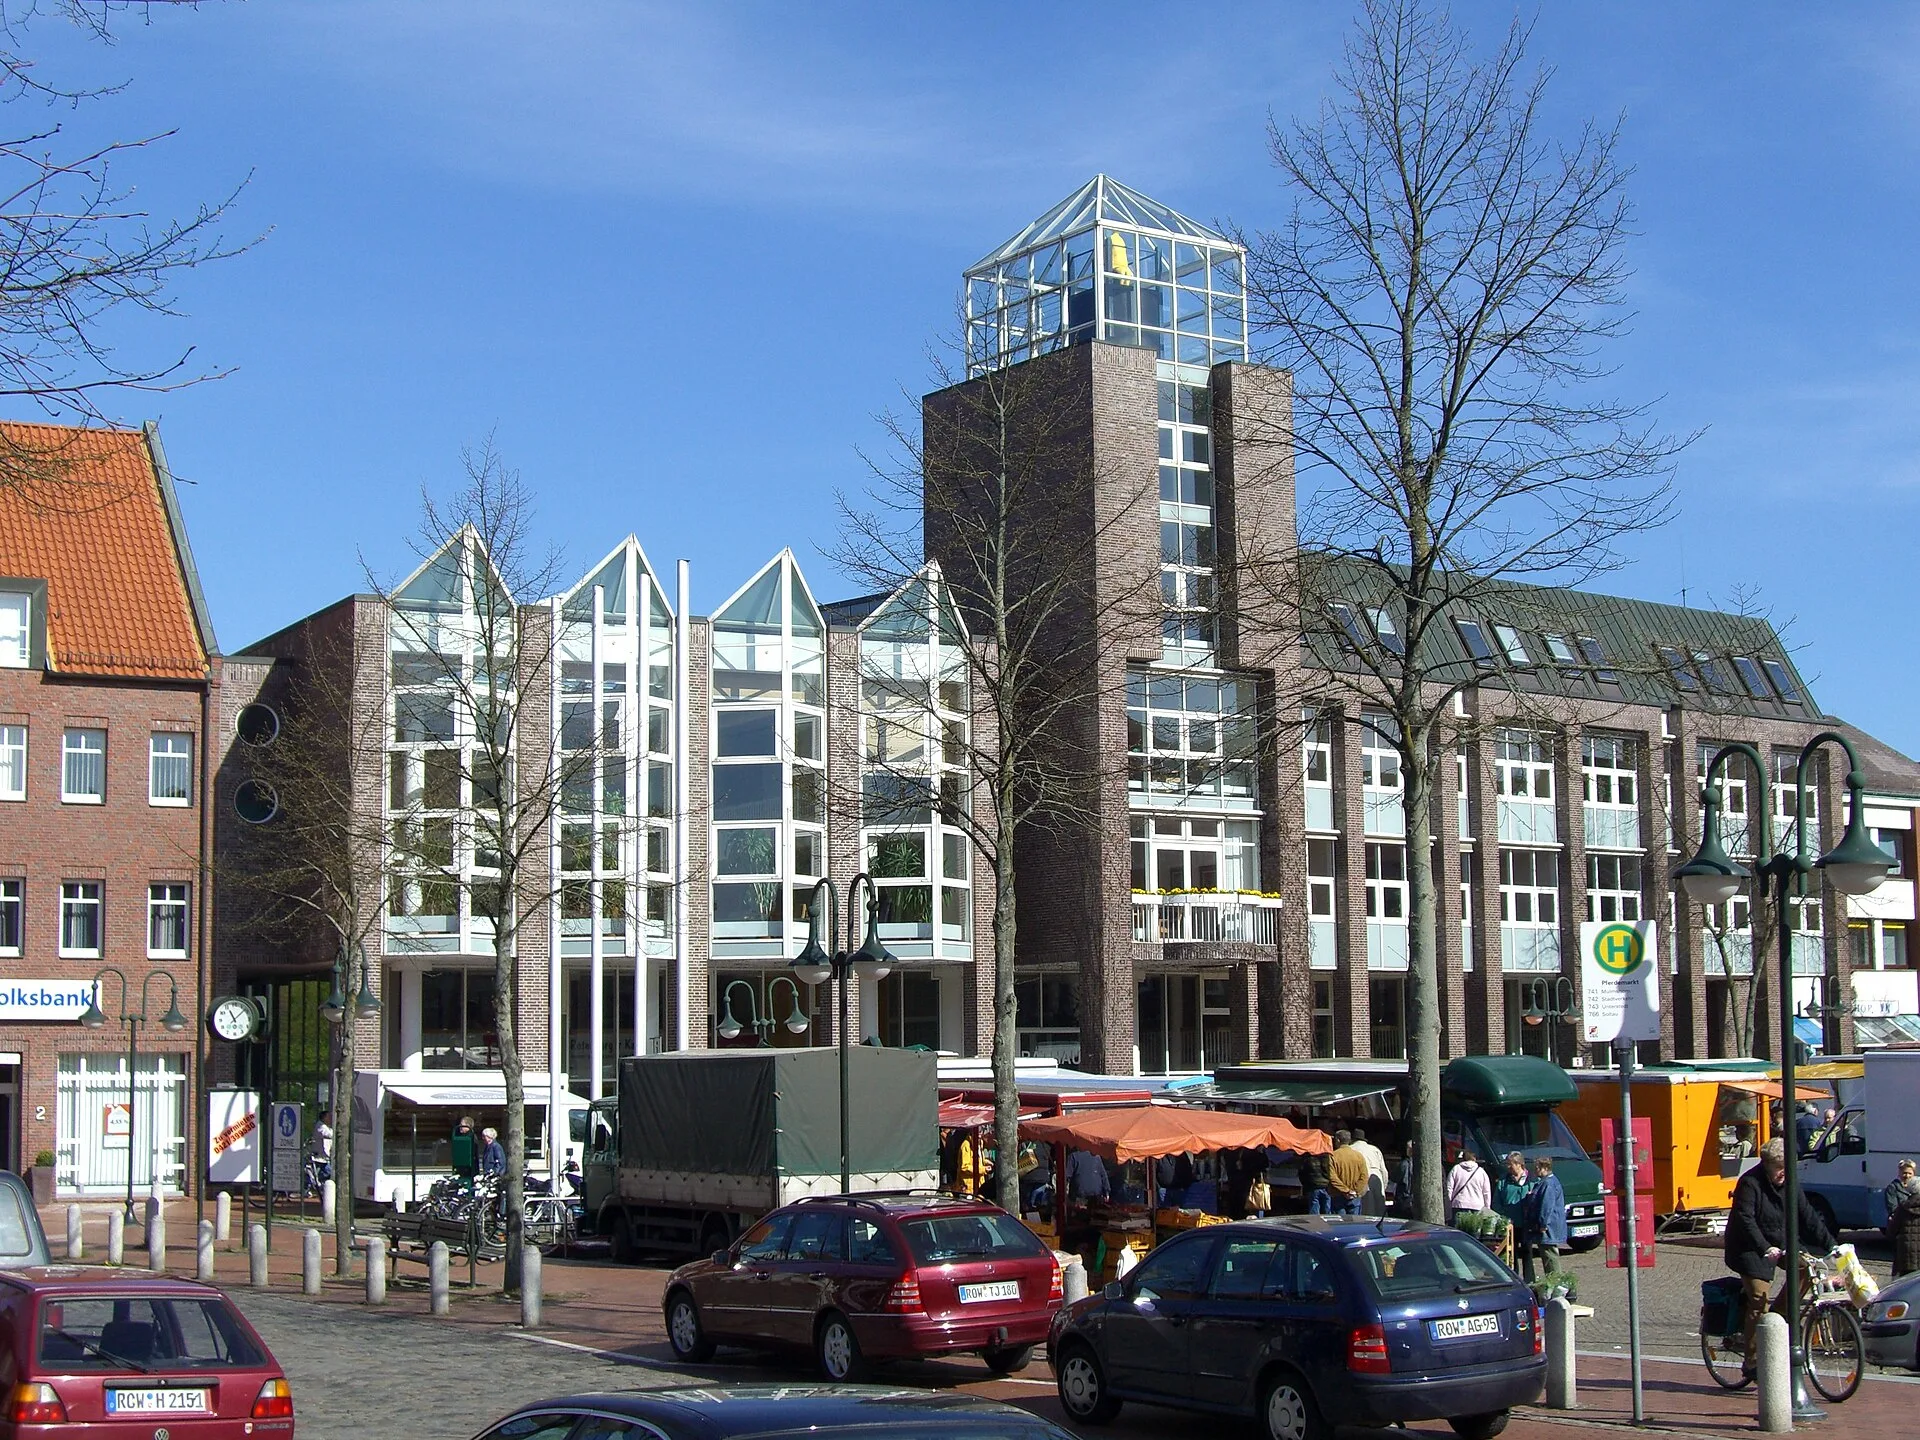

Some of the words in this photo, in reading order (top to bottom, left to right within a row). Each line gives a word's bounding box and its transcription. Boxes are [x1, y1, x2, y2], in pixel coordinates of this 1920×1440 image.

[1606, 935, 1631, 962] H
[35, 1105, 46, 1121] 2
[1437, 1321, 1460, 1337] ROW
[156, 1392, 165, 1408] H
